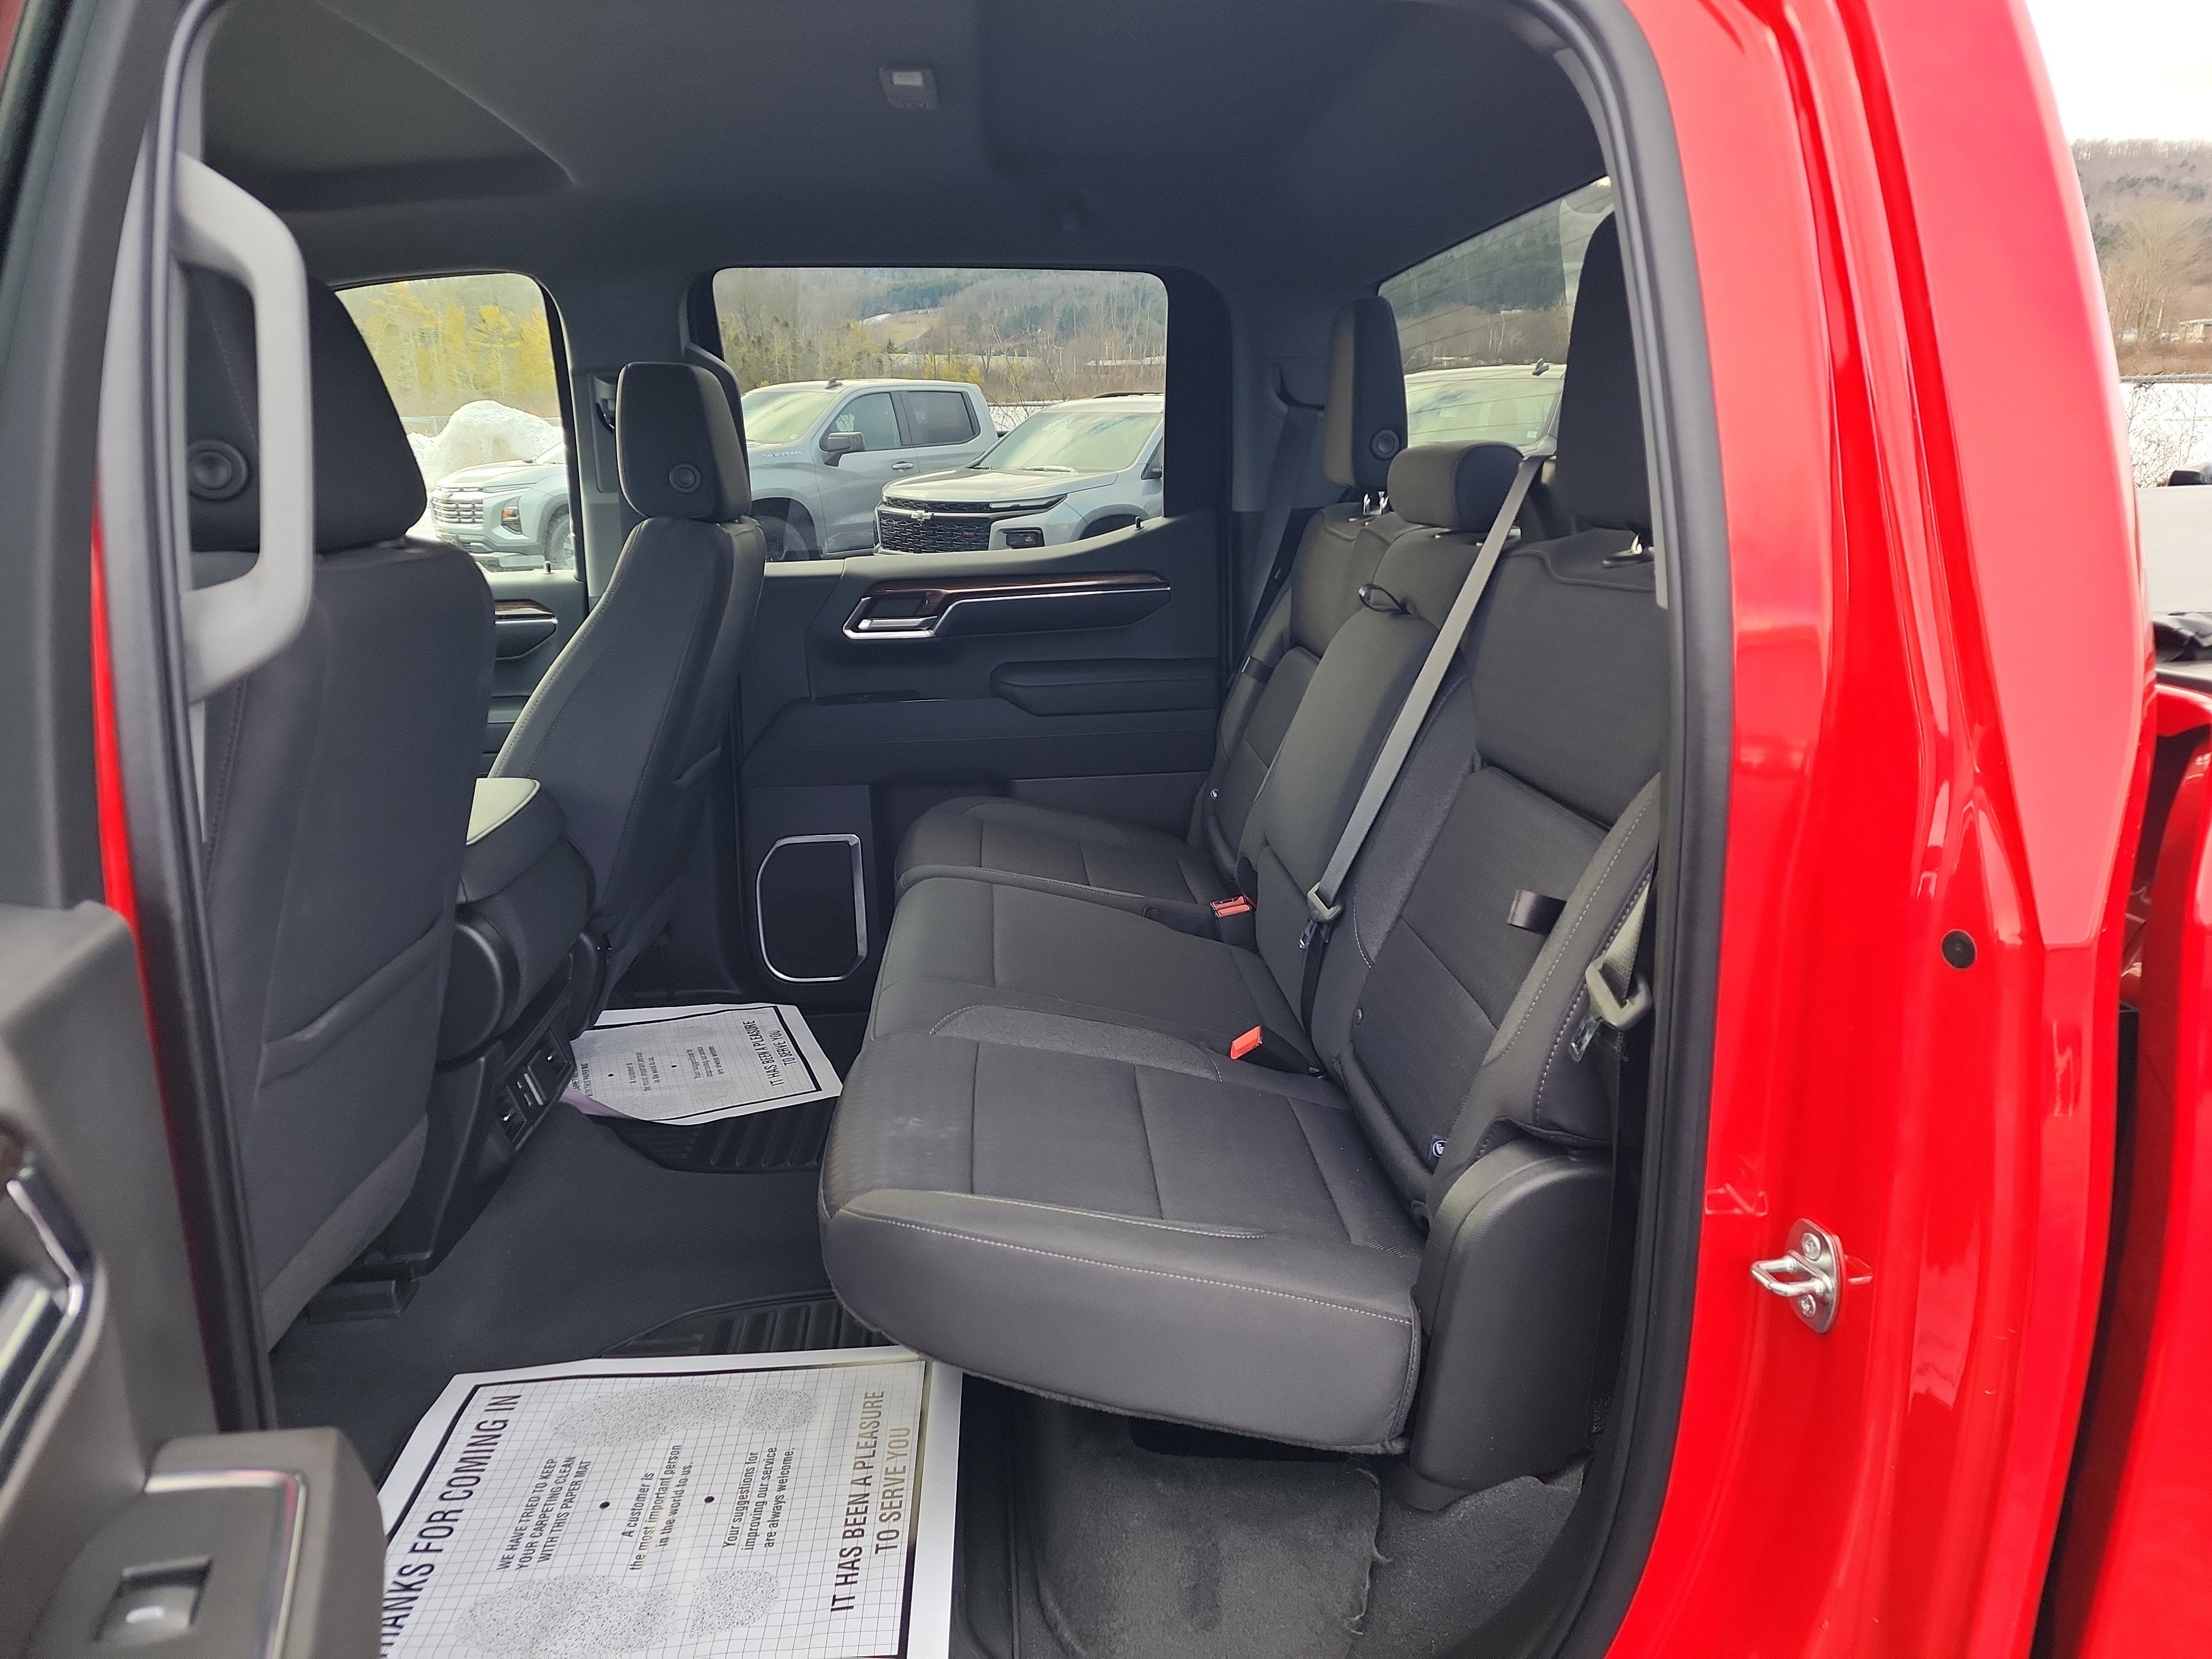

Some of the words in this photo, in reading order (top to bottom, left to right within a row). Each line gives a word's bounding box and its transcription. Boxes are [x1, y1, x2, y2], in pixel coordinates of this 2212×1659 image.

[743, 1020, 766, 1047] PLEASURE
[767, 1030, 783, 1041] YOU
[757, 1051, 775, 1065] BEEN
[773, 1041, 792, 1057] SERVE
[782, 1057, 797, 1066] TO
[764, 1065, 781, 1079] HAS
[853, 1391, 884, 1470] PLEASURE
[886, 1428, 910, 1461] YOU
[539, 1458, 558, 1480] KEEP
[664, 1444, 681, 1475] person
[681, 1462, 693, 1476] us.
[761, 1447, 777, 1481] service
[777, 1447, 795, 1493] welcome.
[532, 1482, 547, 1494] TO
[675, 1478, 688, 1488] to
[757, 1483, 769, 1499] our
[851, 1475, 873, 1486] A
[627, 1483, 650, 1528] customer
[641, 1472, 655, 1480] is
[645, 1477, 671, 1523] important
[668, 1489, 685, 1517] world
[722, 1525, 740, 1548] Your
[732, 1467, 755, 1522] suggestions
[745, 1452, 759, 1465] for
[879, 1465, 906, 1523] SERVE
[515, 1541, 539, 1571] YOUR
[530, 1487, 563, 1538] CARPETING
[555, 1456, 577, 1484] CLEAN
[518, 1496, 540, 1524] TRIED
[537, 1536, 559, 1563] WITH
[550, 1512, 570, 1533] THIS
[561, 1480, 583, 1509] PAPER
[574, 1460, 592, 1478] MAT
[767, 1494, 786, 1528] always
[842, 1493, 870, 1540] BEEN
[380, 1563, 435, 1658] ANKS
[408, 1509, 464, 1553] FOR
[438, 1420, 509, 1501] COMING
[483, 1394, 523, 1412] IN
[660, 1520, 675, 1535] the
[741, 1500, 768, 1551] improving
[505, 1526, 527, 1551] HAVE
[639, 1526, 655, 1551] most
[655, 1536, 669, 1547] in
[764, 1531, 777, 1548] are
[875, 1529, 900, 1554] TO
[496, 1553, 515, 1571] WE
[629, 1554, 646, 1571] the
[834, 1546, 863, 1587] HAS
[830, 1594, 855, 1612] IT
